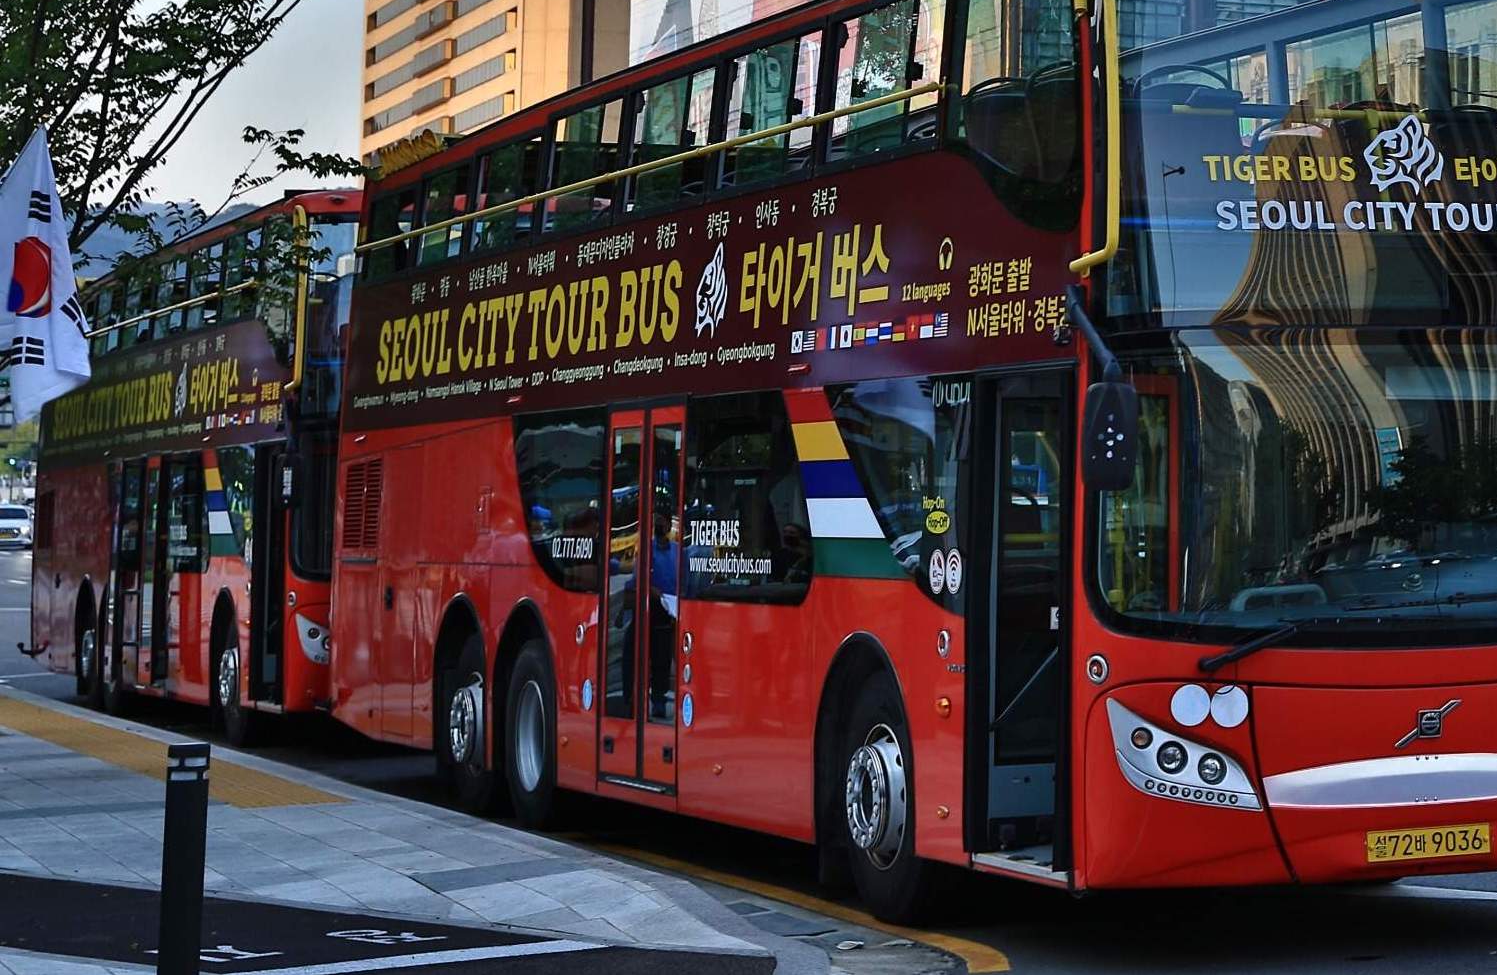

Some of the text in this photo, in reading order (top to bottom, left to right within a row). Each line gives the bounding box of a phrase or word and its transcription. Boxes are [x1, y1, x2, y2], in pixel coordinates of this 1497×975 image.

[1202, 155, 1357, 183] TIGER BUS
[655, 222, 678, 251] 창경궁
[707, 210, 730, 241] 창덕궁
[755, 199, 780, 230] 인사동
[811, 186, 838, 218] 경복궁
[1216, 200, 1337, 231] SEOUL
[1343, 201, 1418, 231] CITY
[739, 224, 890, 329] 타이거 버스
[968, 256, 1032, 300] 광화문 출발
[901, 282, 951, 302] 12 languages
[376, 259, 682, 385] SEOUL CITY TOUR BUS
[493, 378, 508, 391] Seoul
[508, 376, 524, 389] Tower
[531, 371, 544, 386] DDP
[551, 363, 604, 384] Changgyeonggung
[613, 355, 664, 376] Changdeokgung
[674, 349, 708, 367] Insa-dong
[717, 342, 776, 365] Gyeongbokgung
[114, 378, 146, 427] TOUR
[147, 371, 172, 422] BUS
[190, 356, 238, 414] 타이거 버스
[922, 495, 945, 511] Hop-On
[690, 520, 740, 546] TIGER BUS
[928, 516, 948, 527] Hop-Off
[552, 537, 593, 560] 02.777.6090
[689, 552, 772, 578] www.seoulcitybus.com
[1431, 829, 1483, 853] 9036
